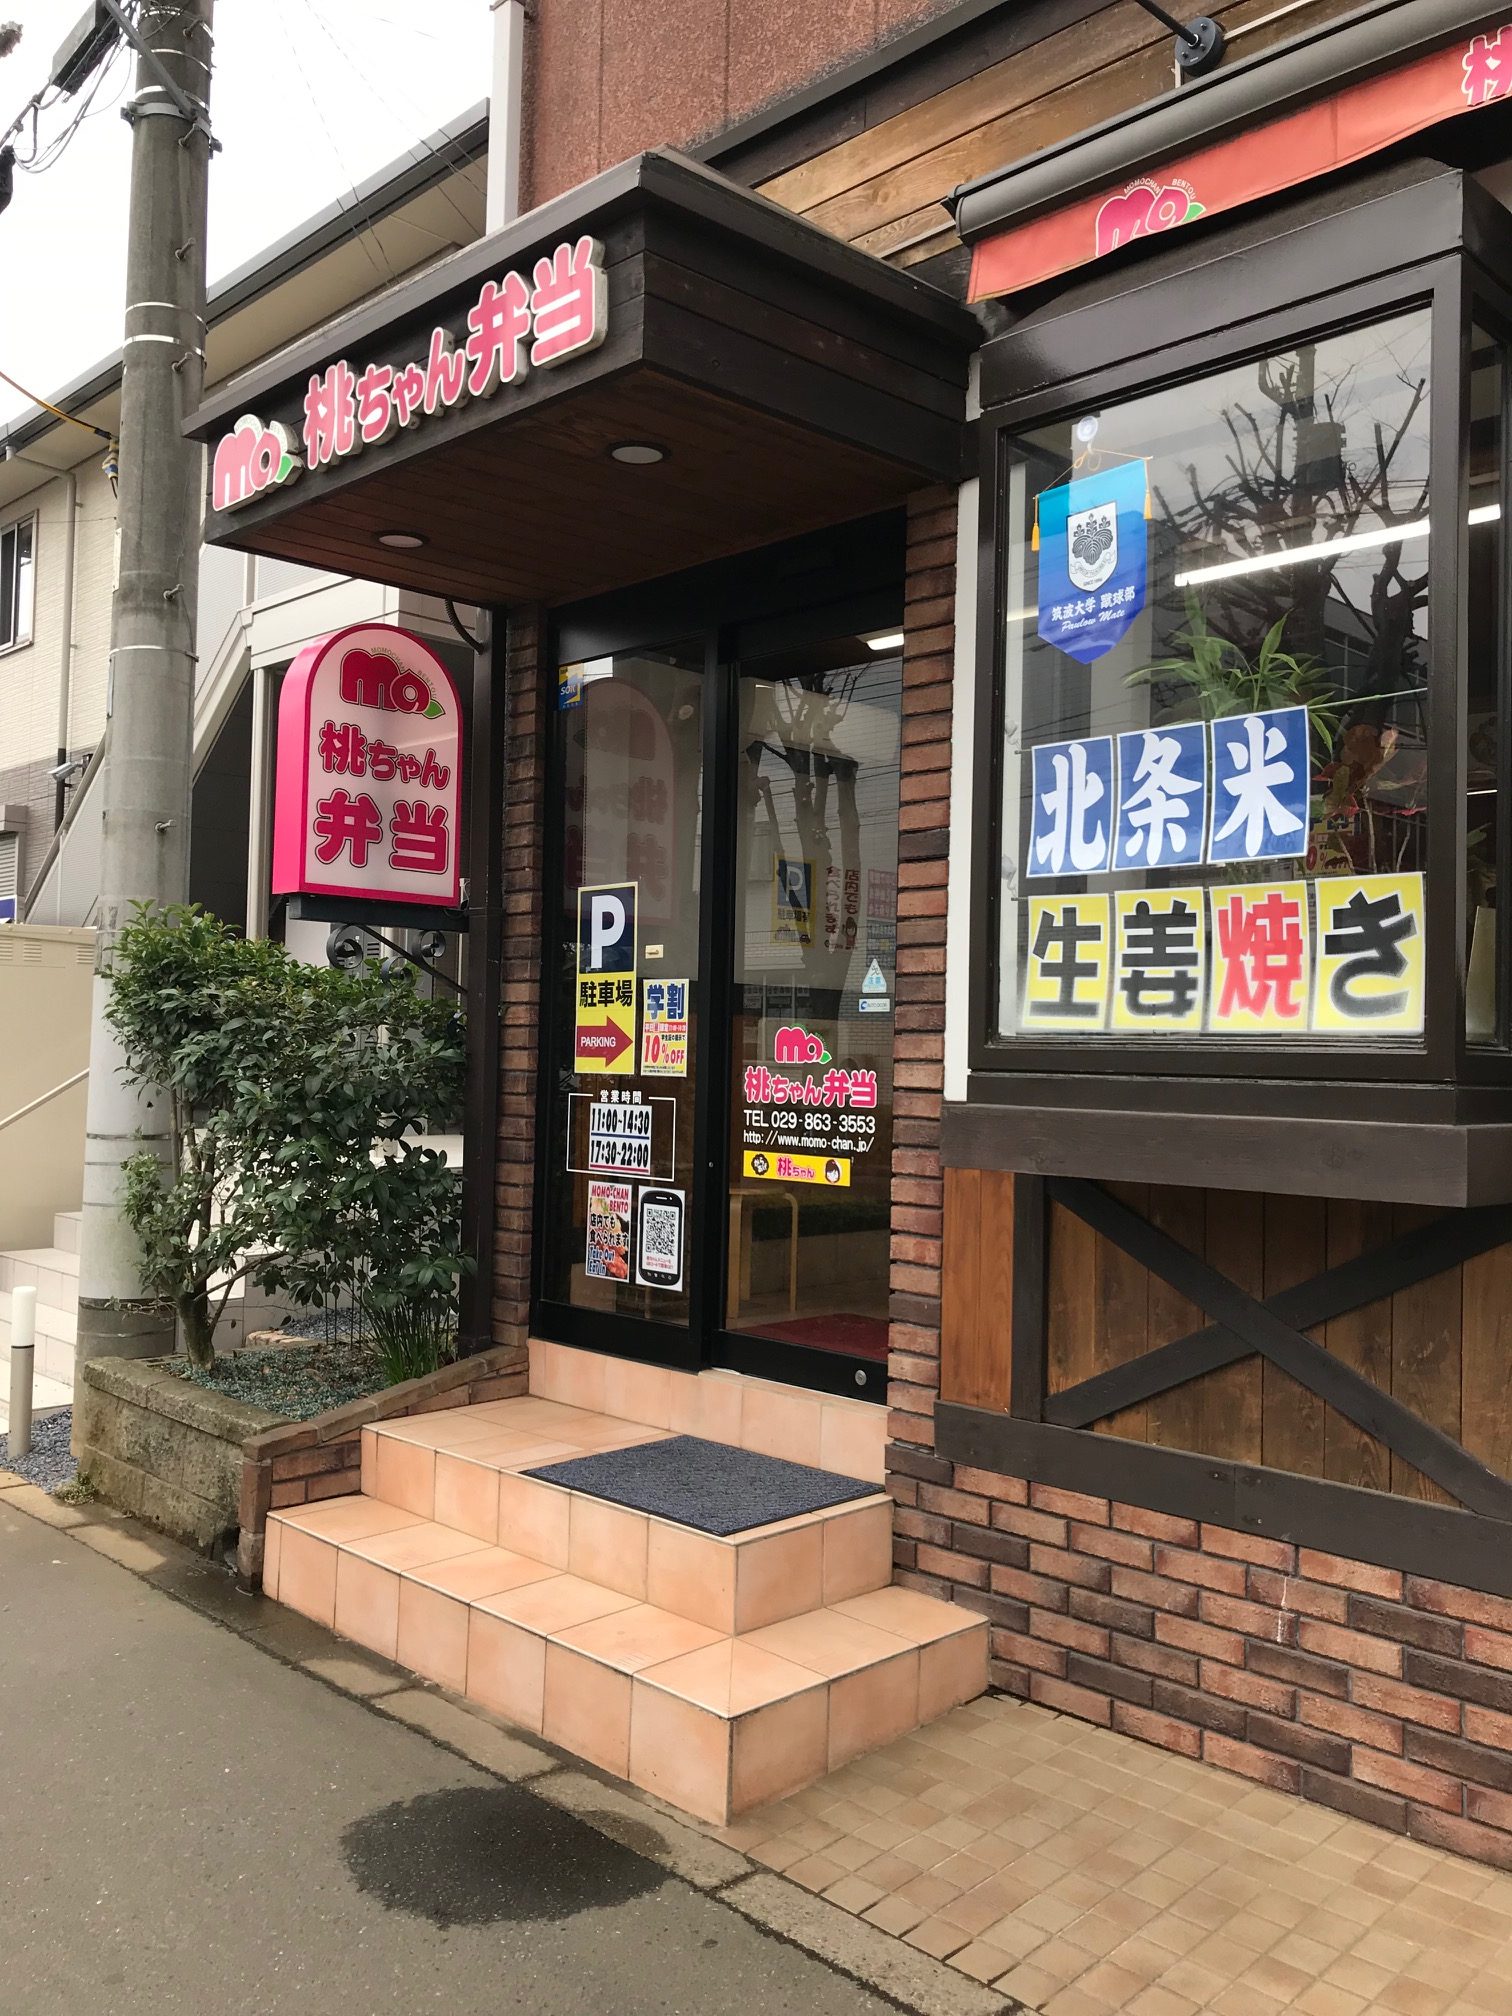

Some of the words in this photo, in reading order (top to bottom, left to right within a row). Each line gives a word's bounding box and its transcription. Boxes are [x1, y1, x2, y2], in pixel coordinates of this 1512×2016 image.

[1123, 177, 1161, 194] MOMOCHAN
[1171, 178, 1196, 200] BENTOU
[303, 235, 596, 471] 桃ちゃん弁当
[1051, 597, 1097, 622] 筑波大学
[318, 719, 451, 791] 桃ちゃん
[1034, 715, 1305, 875] 北条米
[313, 788, 449, 875] 弁当
[591, 894, 626, 969] P
[1029, 891, 1417, 1019] 生姜焼き
[579, 980, 633, 1008] 駐車場
[647, 983, 686, 1020] 学割
[580, 1036, 617, 1048] PARKING
[600, 1090, 642, 1104] 営業時間
[744, 1065, 878, 1109] 桃ちゃん弁当
[743, 1109, 769, 1127] TEL
[770, 1112, 876, 1134] 029-863-3553
[777, 1156, 815, 1178] 桃ちゃん
[609, 1200, 629, 1214] BENTO
[590, 1214, 616, 1229] 店内でも
[589, 1230, 629, 1248] 食べられます
